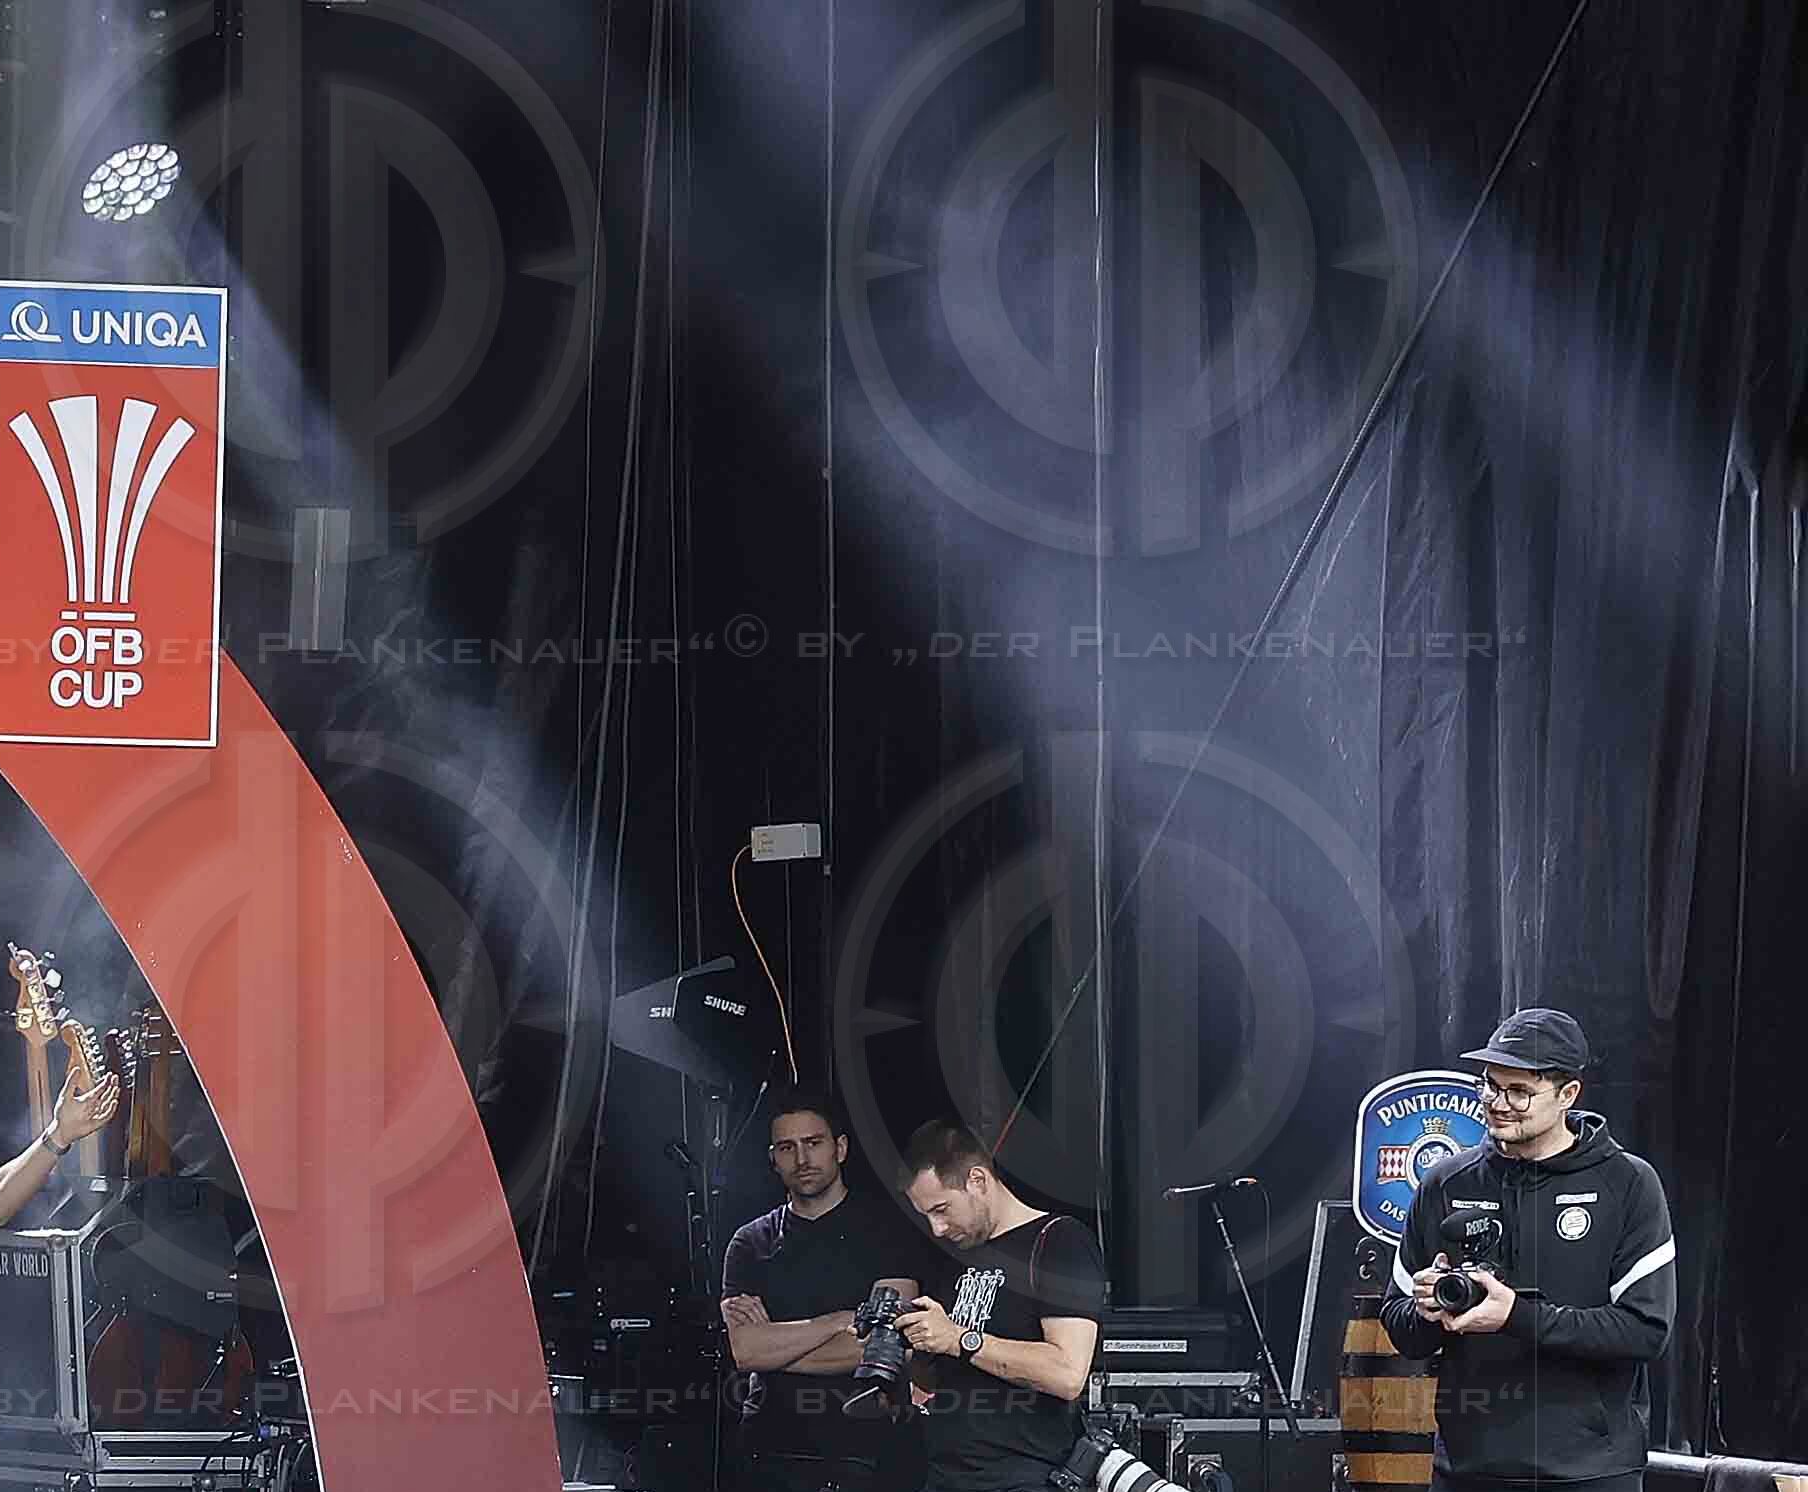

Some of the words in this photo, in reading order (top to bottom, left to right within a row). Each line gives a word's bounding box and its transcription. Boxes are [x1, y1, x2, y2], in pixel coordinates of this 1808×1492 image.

[72, 309, 208, 348] UNIQA
[49, 669, 143, 709] CUP
[704, 995, 747, 1016] SHURE
[1379, 1199, 1407, 1223] DAS
[13, 1252, 49, 1277] WORLD
